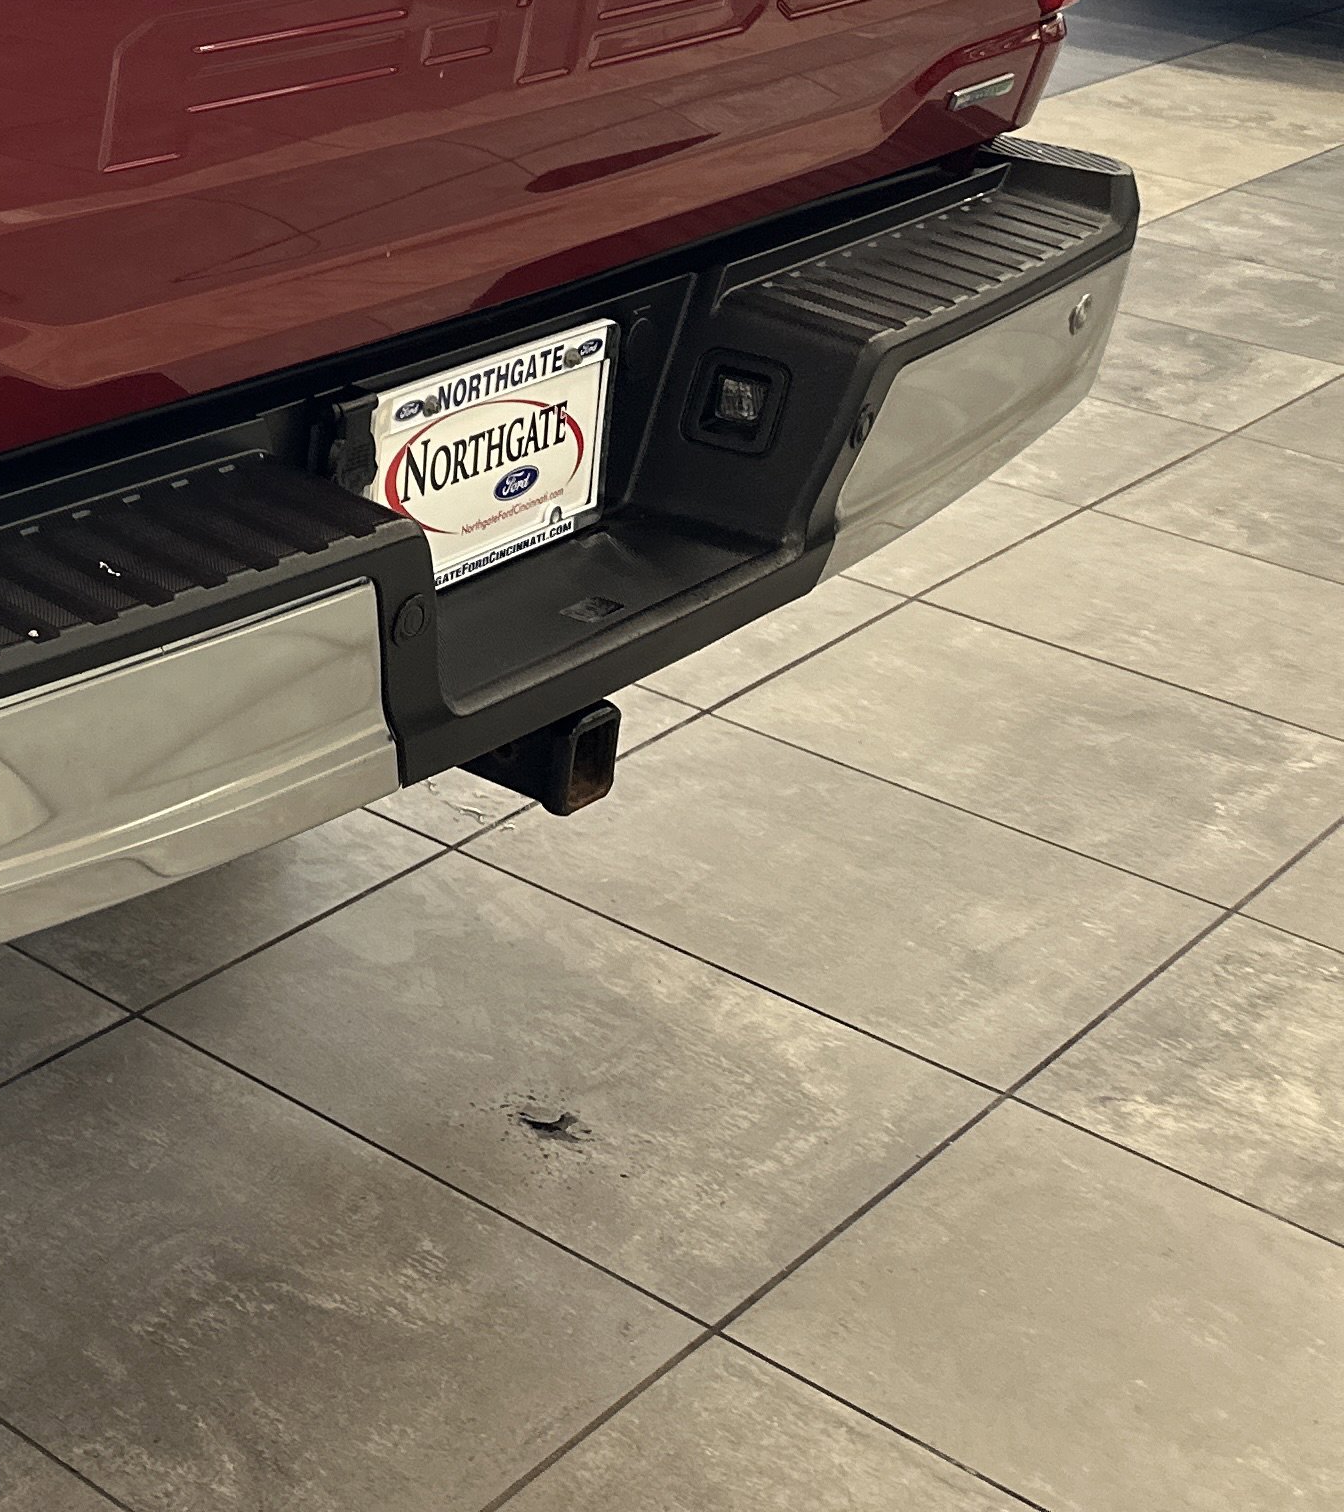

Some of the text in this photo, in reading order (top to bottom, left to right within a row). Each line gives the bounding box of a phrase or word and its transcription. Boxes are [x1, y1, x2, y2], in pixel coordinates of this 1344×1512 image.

[437, 344, 565, 411] NORTHGATE
[461, 488, 564, 536] NorthgateFordCincinnati.com
[435, 521, 572, 586] GATEFORDCINCINNATI.COM
